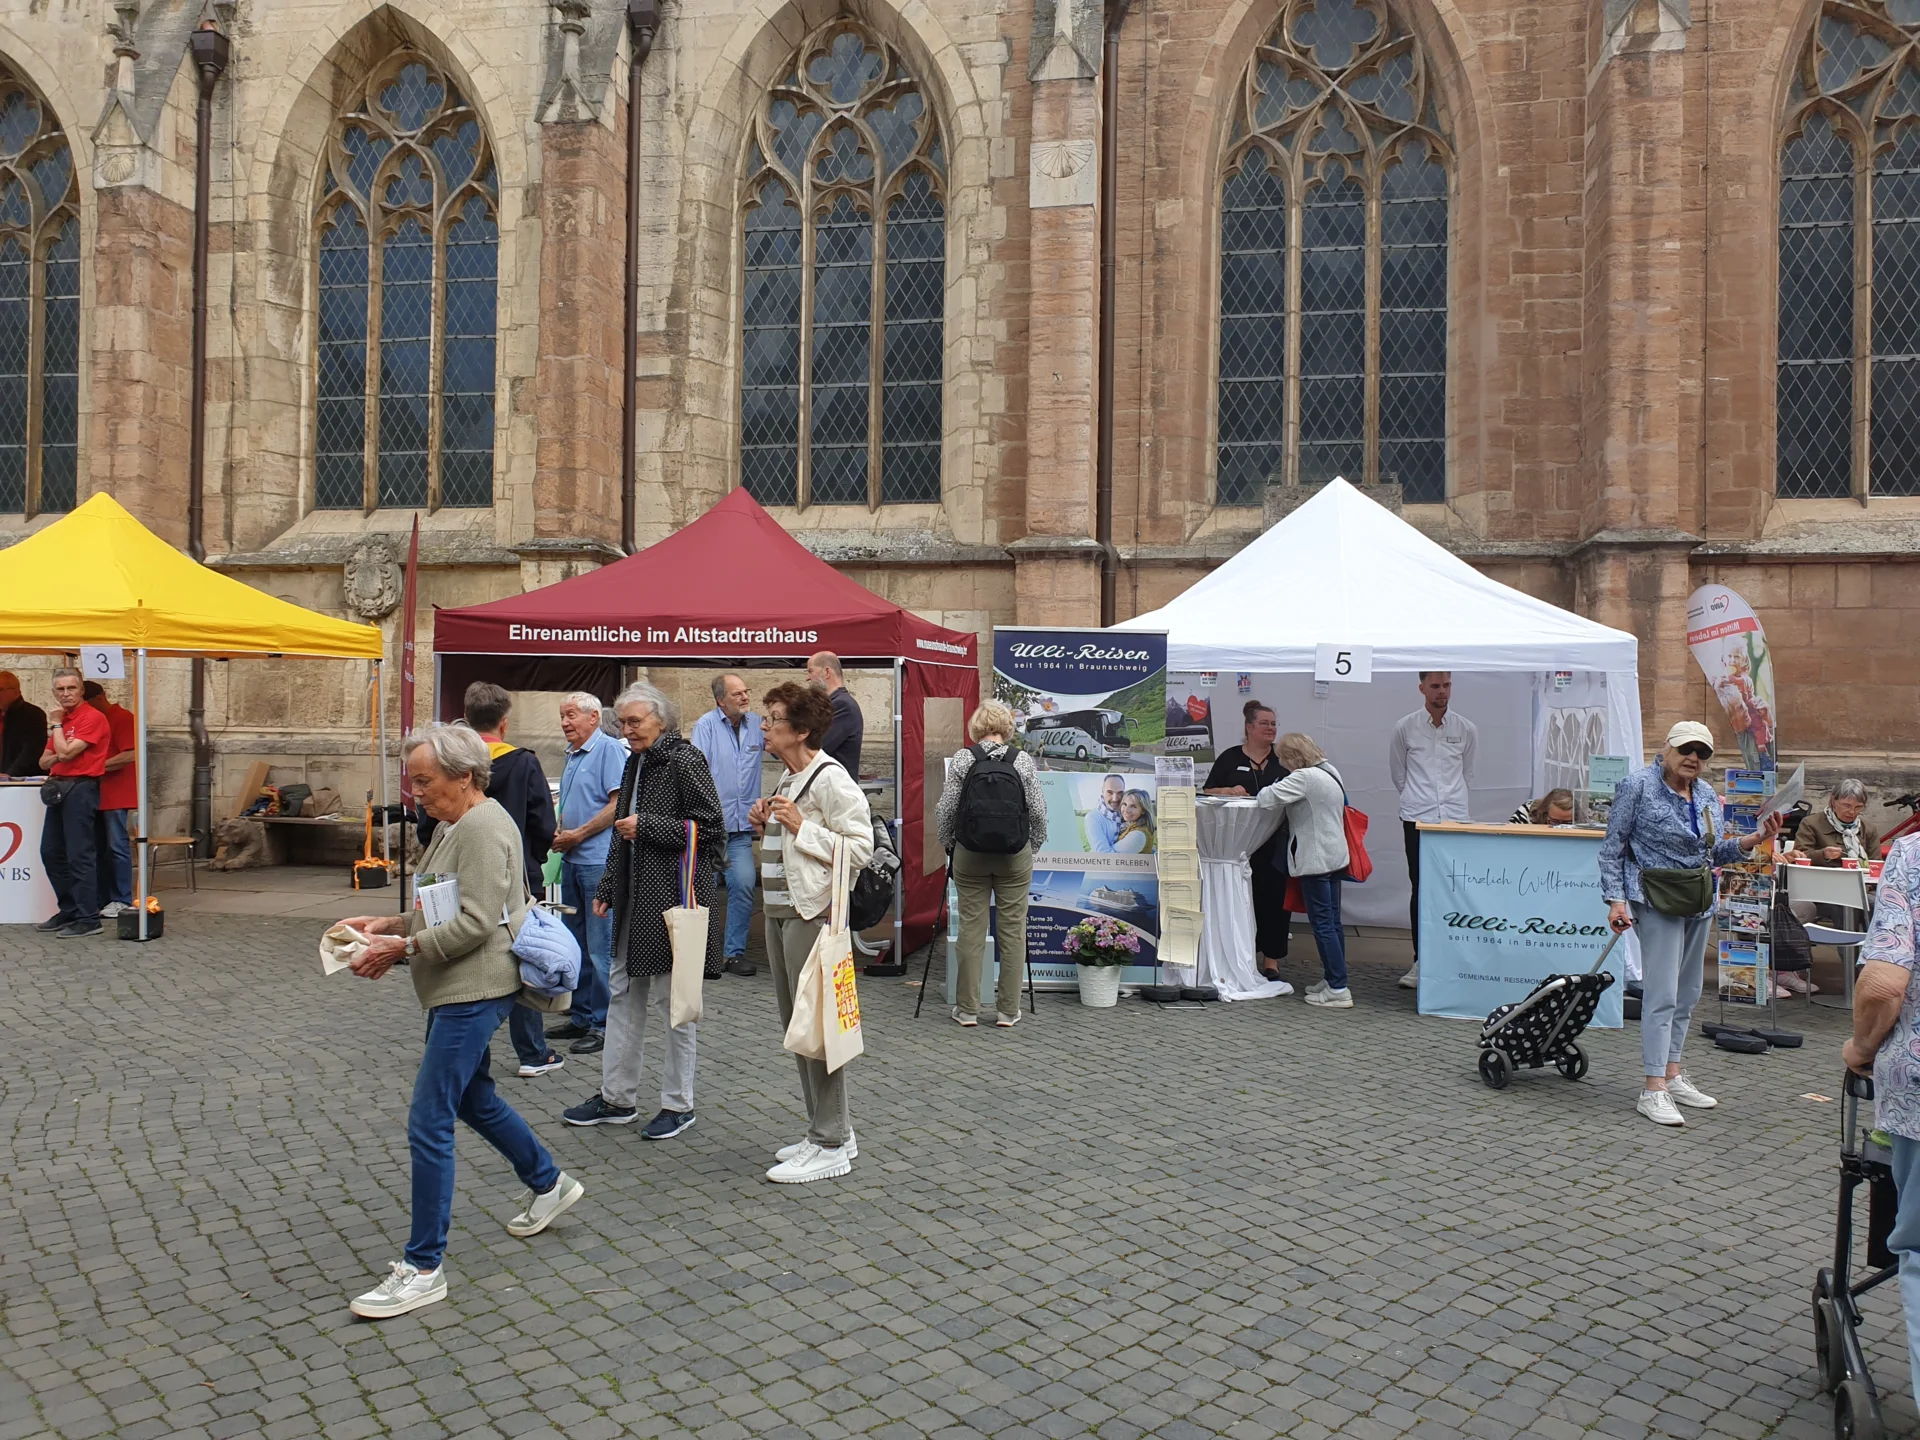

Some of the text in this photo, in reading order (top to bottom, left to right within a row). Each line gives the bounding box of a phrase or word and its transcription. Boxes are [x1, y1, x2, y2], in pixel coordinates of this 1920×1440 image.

[509, 624, 818, 643] Ehrenamtliche im Altstadtrathaus
[1010, 642, 1150, 660] Ulli-Reisen
[96, 653, 110, 674] 3
[1038, 662, 1061, 670] 1964
[1079, 663, 1148, 672] Braunschweig
[1335, 651, 1352, 675] 5
[1040, 730, 1076, 746] Ulli
[1052, 857, 1111, 866] REISEMOMENTE
[1115, 859, 1150, 867] ERLEBEN
[12, 867, 31, 881] BS
[1447, 859, 1512, 892] Herzlich
[1443, 911, 1609, 937] Ulli-Reisen
[1448, 934, 1608, 950] seit 1964 in Braunschweig
[1030, 969, 1079, 978] WWW.ULLI-
[1458, 972, 1542, 985] GEMEINSAM REISEMOM
